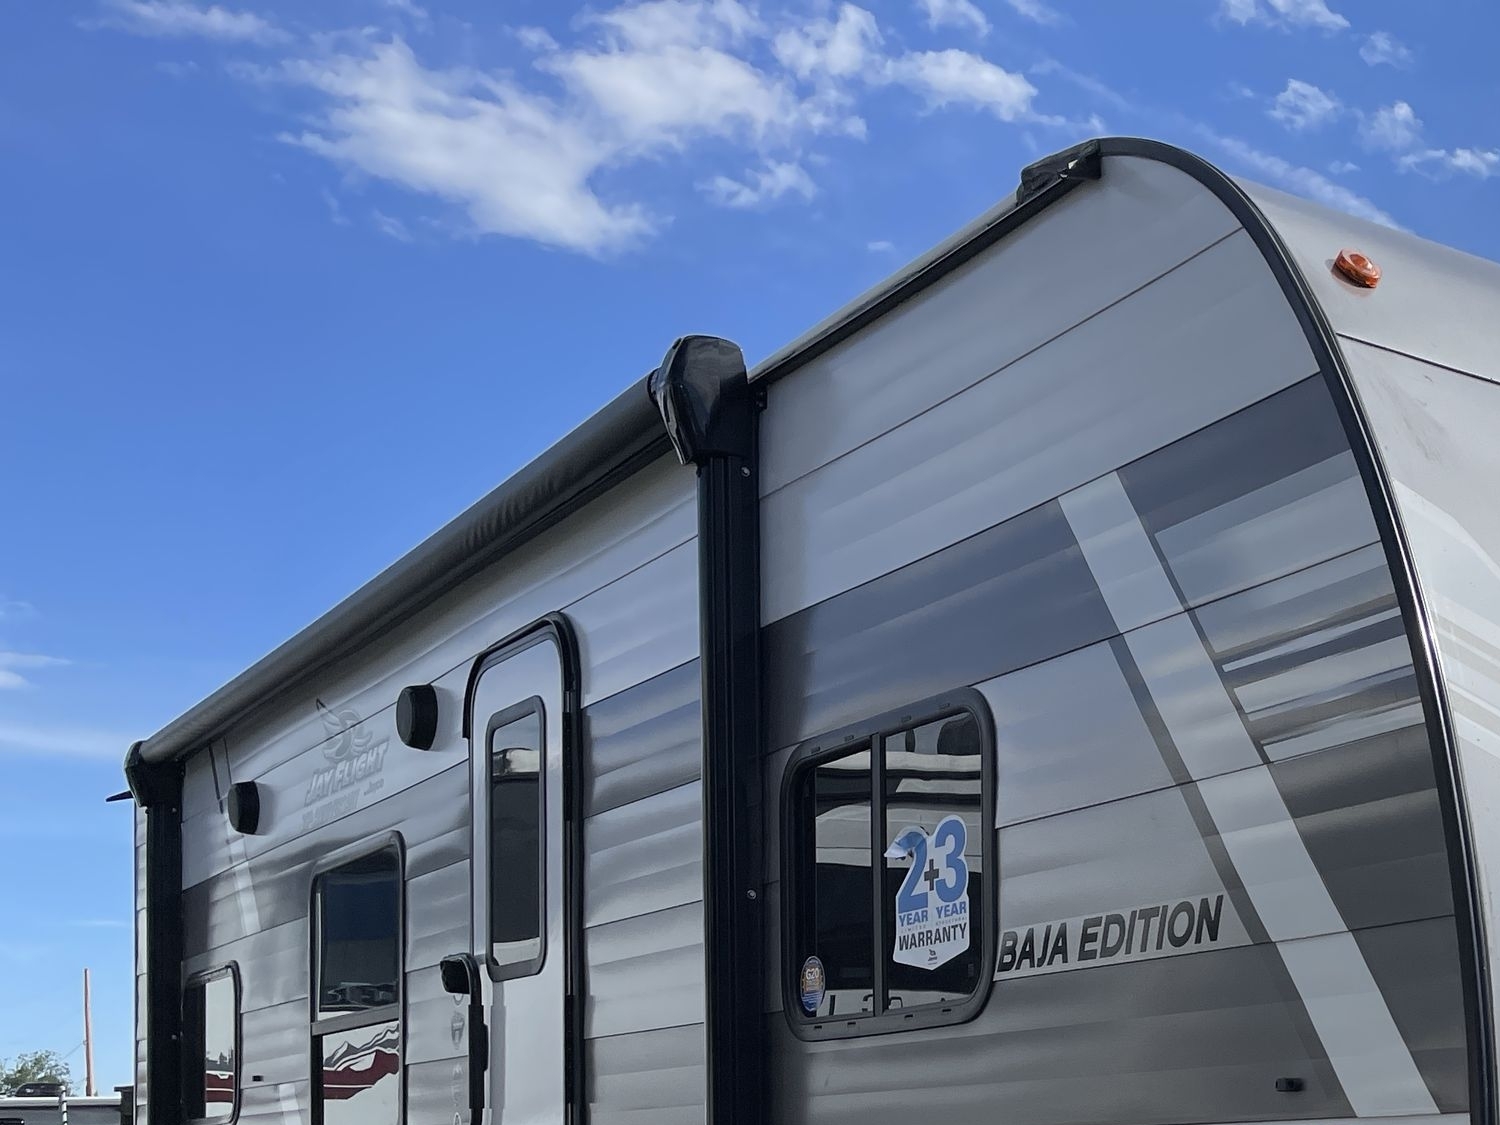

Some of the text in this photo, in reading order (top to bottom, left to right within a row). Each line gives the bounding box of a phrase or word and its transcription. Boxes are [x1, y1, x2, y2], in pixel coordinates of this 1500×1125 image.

[899, 901, 967, 927] YEAR YEAR
[899, 922, 967, 951] WARRANTY
[997, 895, 1224, 972] BAJA EDITION
